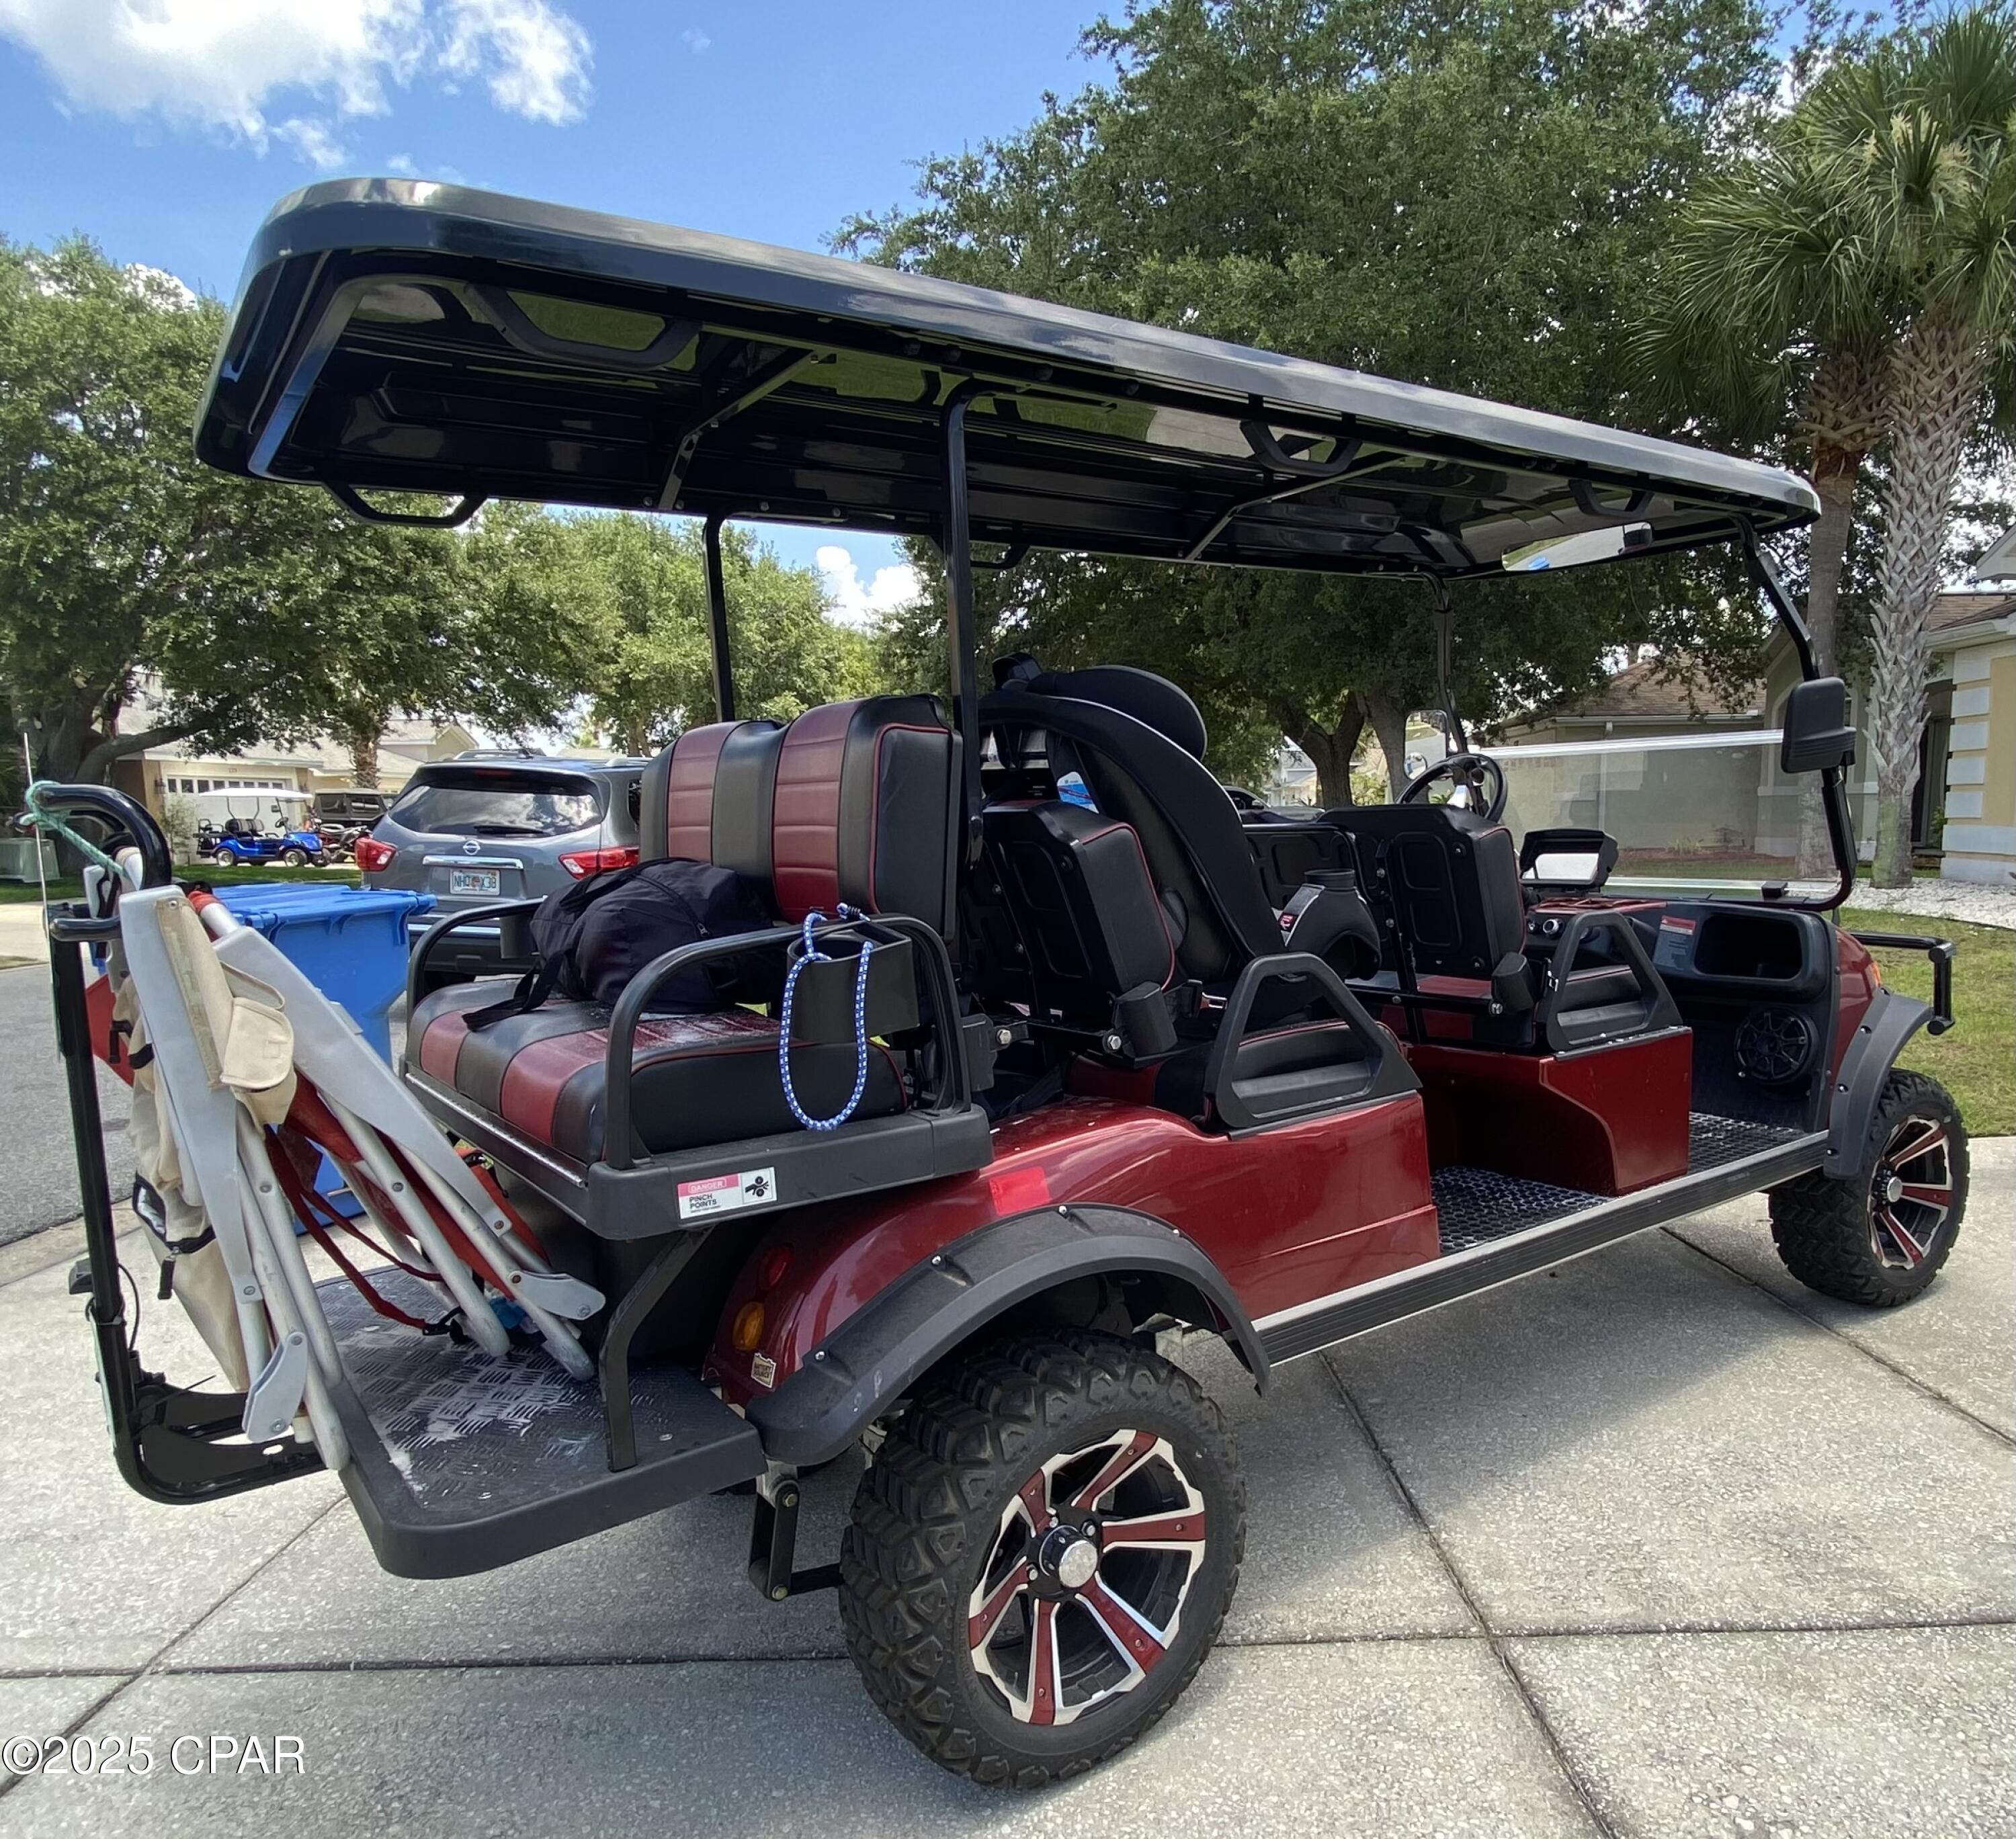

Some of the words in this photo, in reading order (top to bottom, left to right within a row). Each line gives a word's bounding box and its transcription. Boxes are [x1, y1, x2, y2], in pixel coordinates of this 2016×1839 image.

[691, 1180, 724, 1191] DANGER
[689, 1193, 712, 1203] PINCH
[689, 1199, 718, 1209] POINTS
